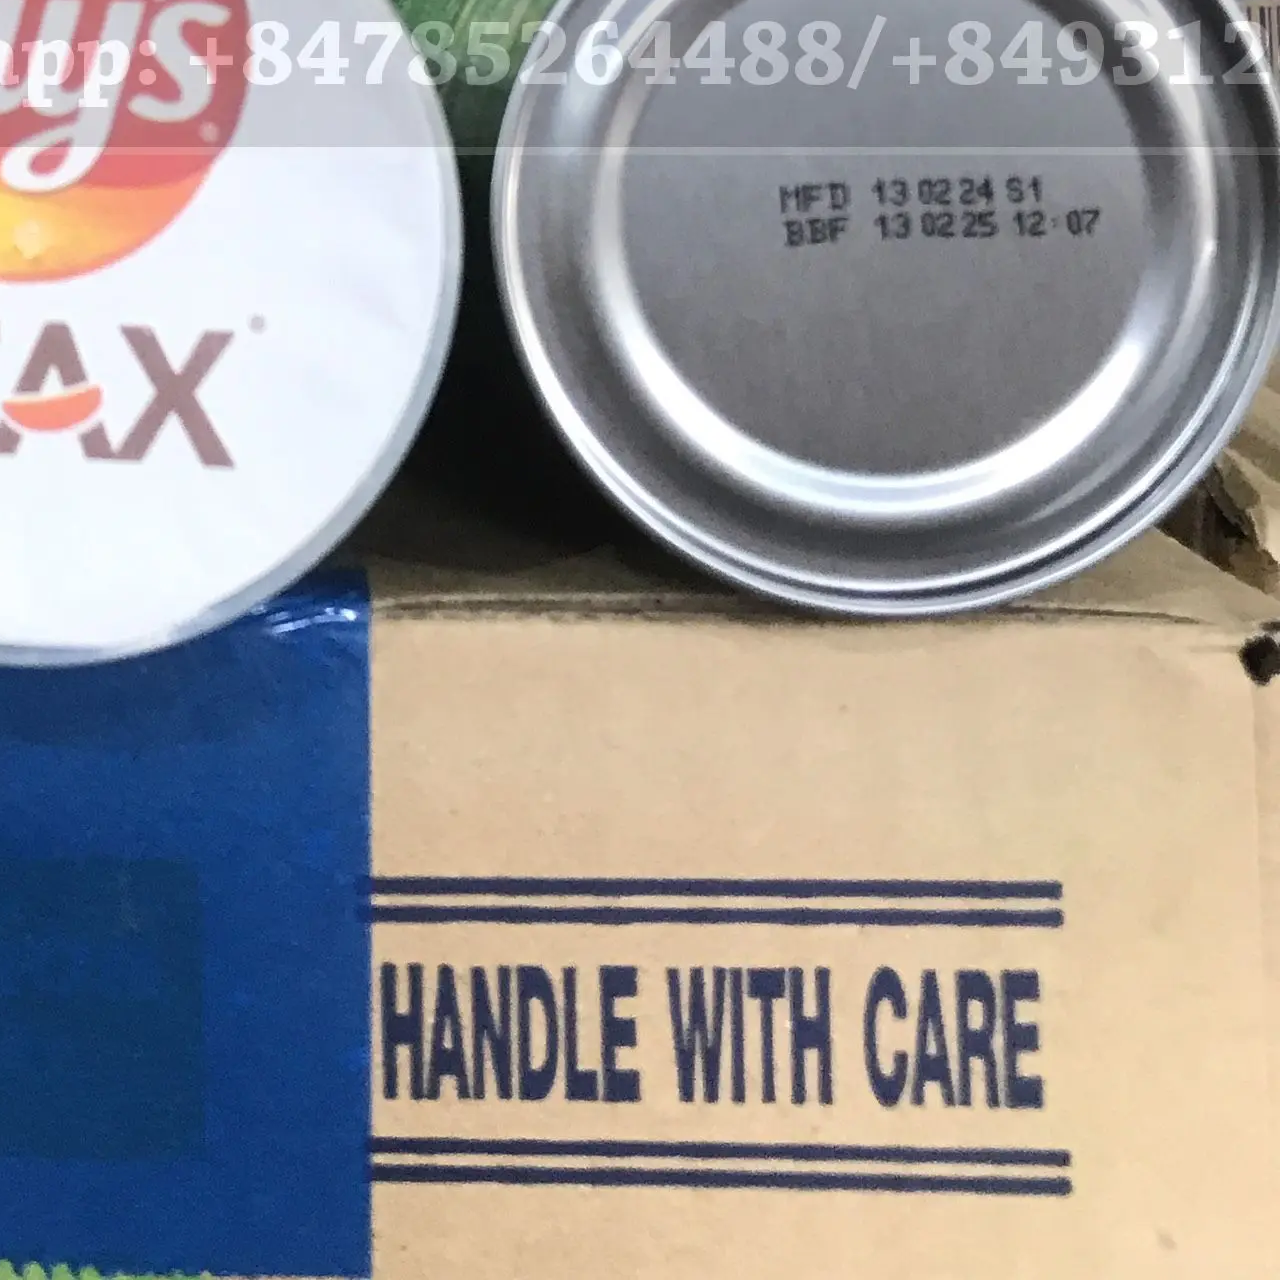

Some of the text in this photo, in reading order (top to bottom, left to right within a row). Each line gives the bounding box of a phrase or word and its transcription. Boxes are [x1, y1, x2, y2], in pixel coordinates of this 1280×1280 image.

[778, 182, 852, 213] MFD
[871, 177, 911, 207] 13
[917, 177, 952, 206] 02
[958, 176, 994, 206] 24
[783, 217, 849, 247] BBF
[874, 212, 912, 241] 13
[919, 211, 956, 238] 02
[962, 210, 1000, 238] 25
[380, 961, 1045, 1110] HANDLE WITH CARE
